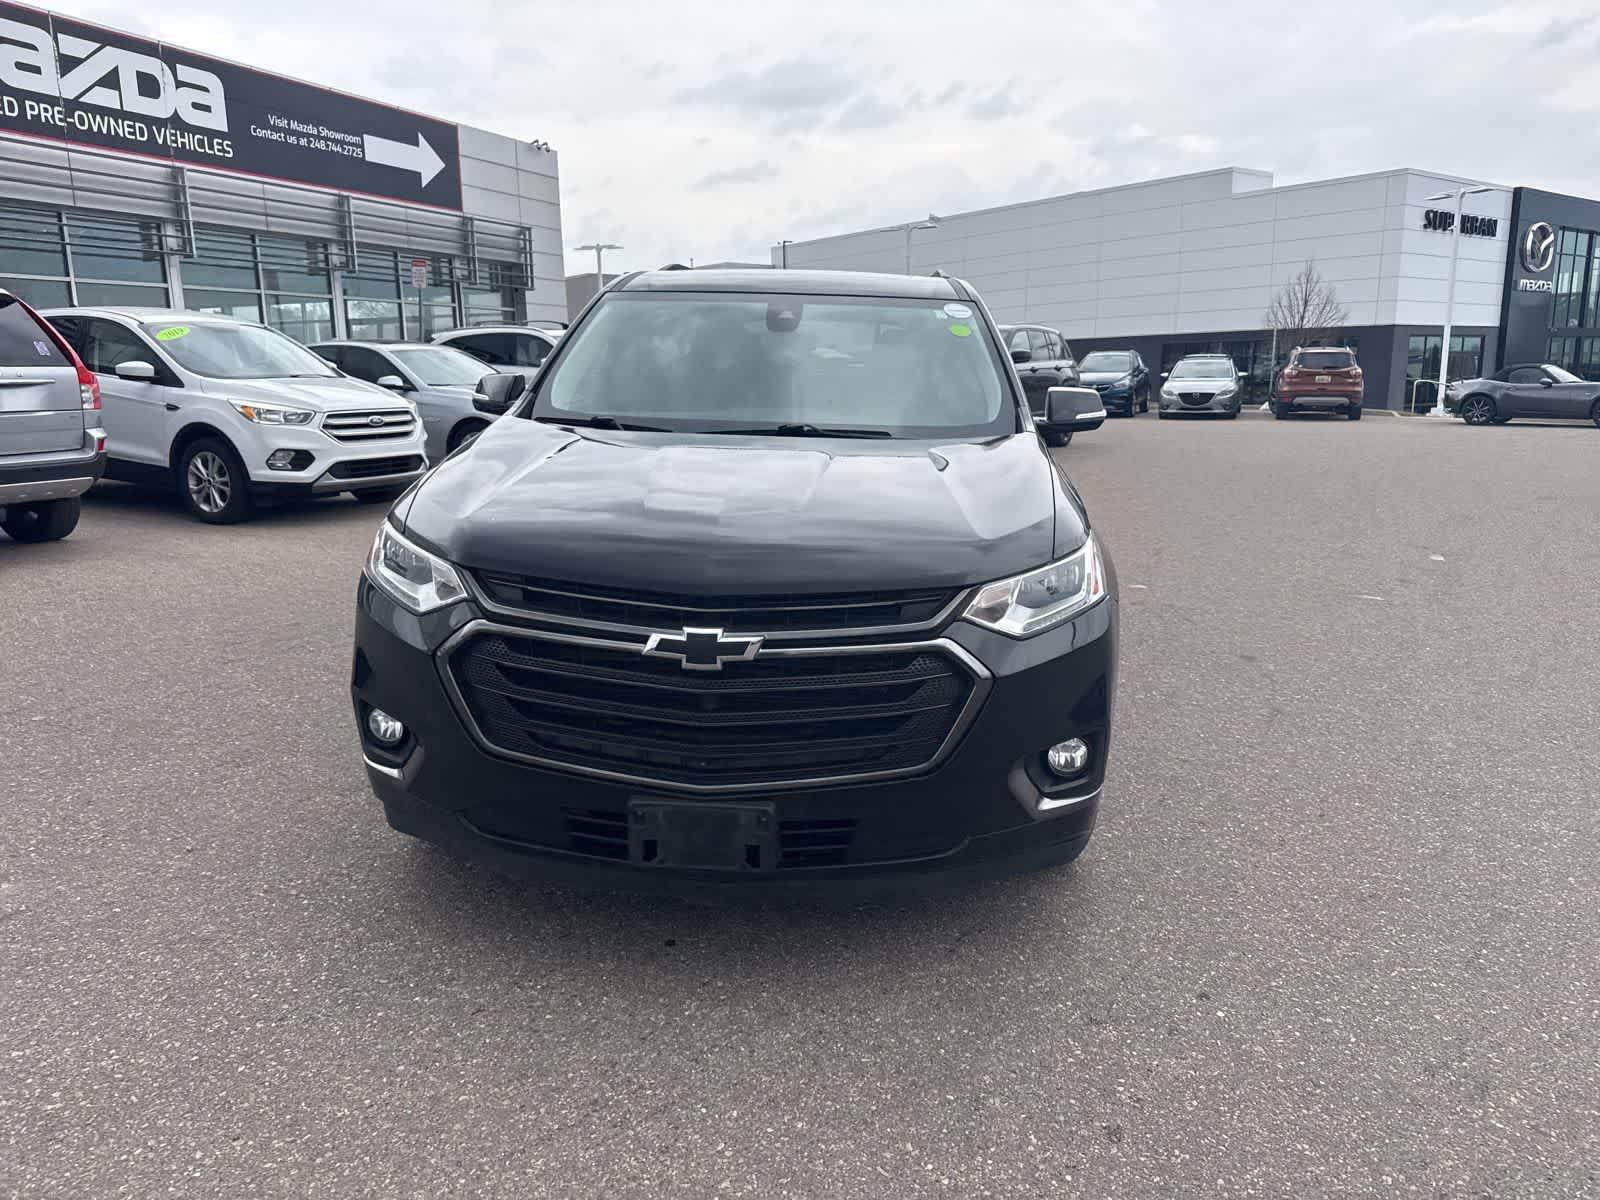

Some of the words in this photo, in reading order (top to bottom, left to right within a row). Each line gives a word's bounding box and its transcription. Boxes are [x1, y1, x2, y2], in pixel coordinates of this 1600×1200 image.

[25, 100, 148, 142] PRE-OWNED
[153, 126, 234, 158] VEHICLES
[250, 125, 286, 142] Contact
[287, 135, 298, 144] us
[299, 137, 308, 147] at
[309, 138, 363, 158] 248.744.2725
[268, 114, 288, 129] Visit
[290, 120, 318, 135] Mazda
[319, 126, 362, 145] Showroom
[1423, 209, 1498, 237] SUBRBAN
